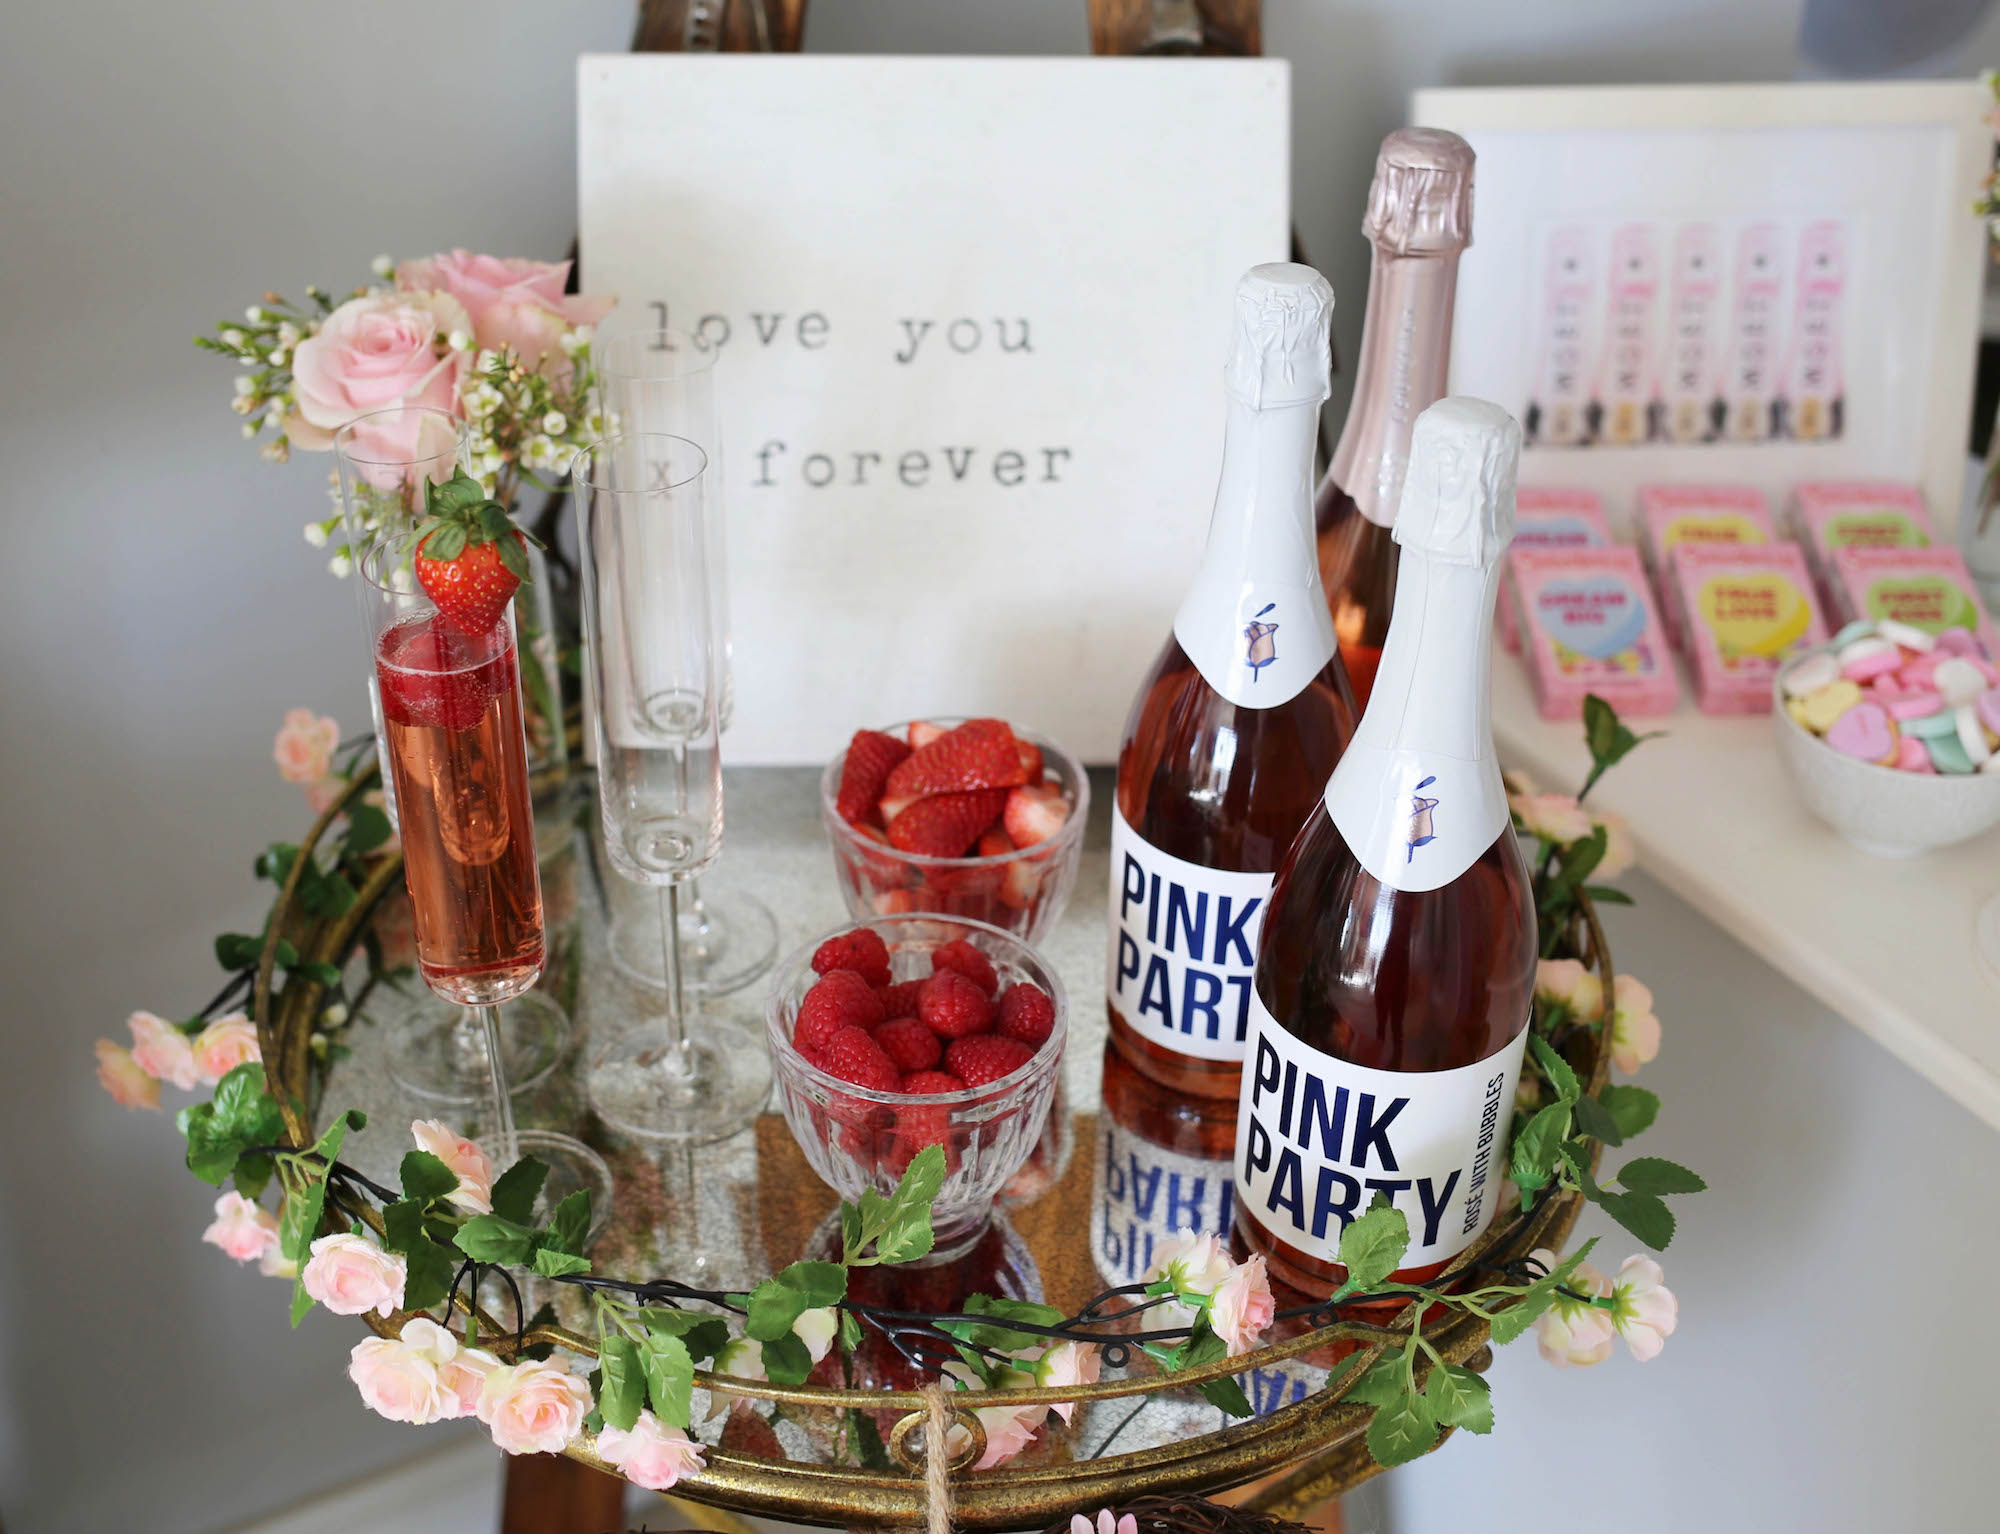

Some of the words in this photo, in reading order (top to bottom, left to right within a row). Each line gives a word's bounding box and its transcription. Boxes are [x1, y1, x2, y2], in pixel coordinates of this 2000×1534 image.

[648, 301, 831, 352] love
[894, 314, 1035, 365] you
[752, 439, 1072, 488] forever
[1121, 850, 1264, 968] PINK
[1116, 925, 1253, 1042] PART
[1252, 1031, 1411, 1172] PINK
[1476, 1072, 1505, 1150] BUBBLES
[1470, 1146, 1492, 1194] WITH
[1462, 1188, 1484, 1235] ROSÉ
